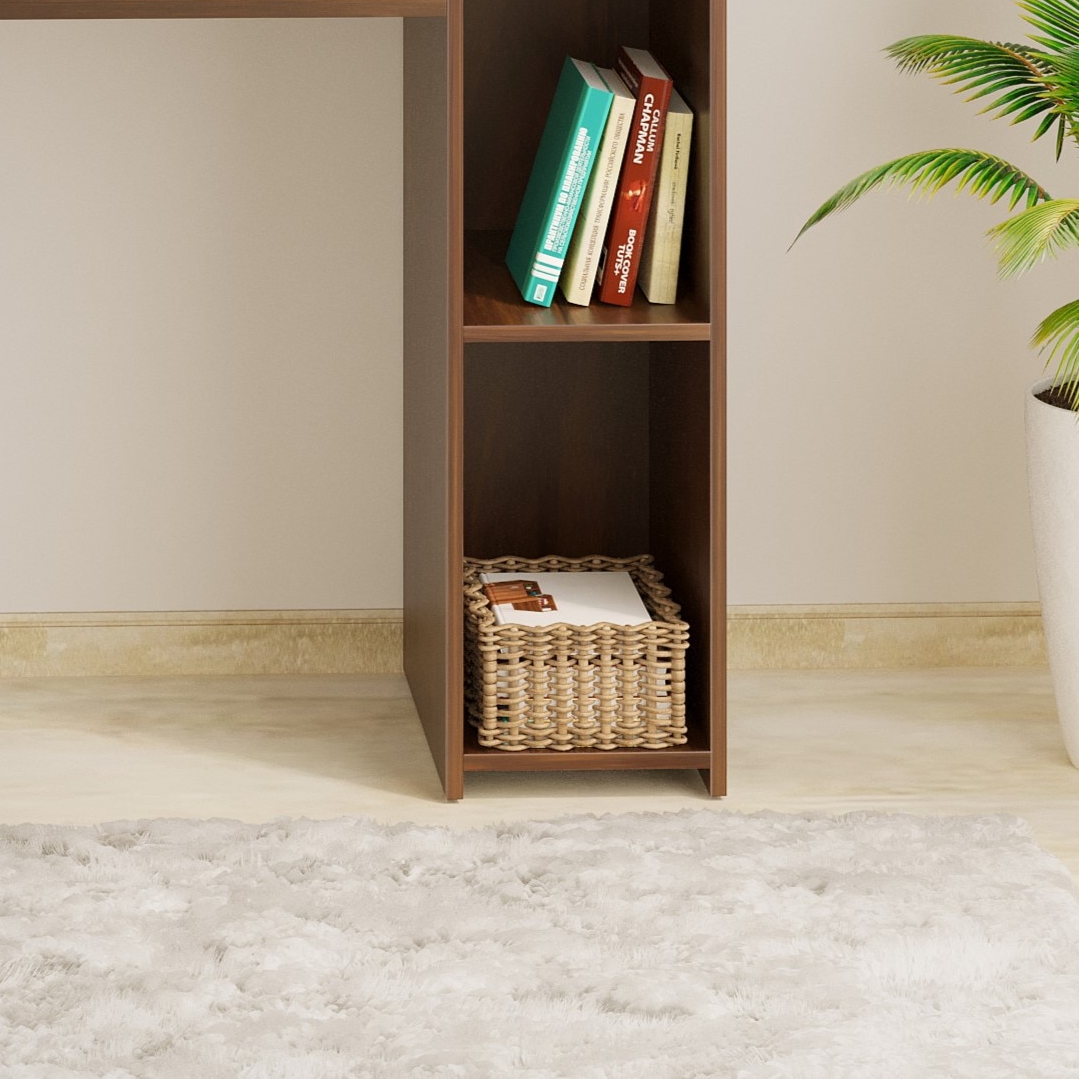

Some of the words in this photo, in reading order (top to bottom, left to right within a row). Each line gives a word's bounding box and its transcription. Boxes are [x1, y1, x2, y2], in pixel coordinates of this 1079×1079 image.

[633, 93, 654, 164] CHAPMAN
[646, 109, 660, 152] CALLUM
[614, 244, 626, 276] TUTS+
[623, 229, 637, 259] BOOK
[618, 260, 631, 294] COVER
